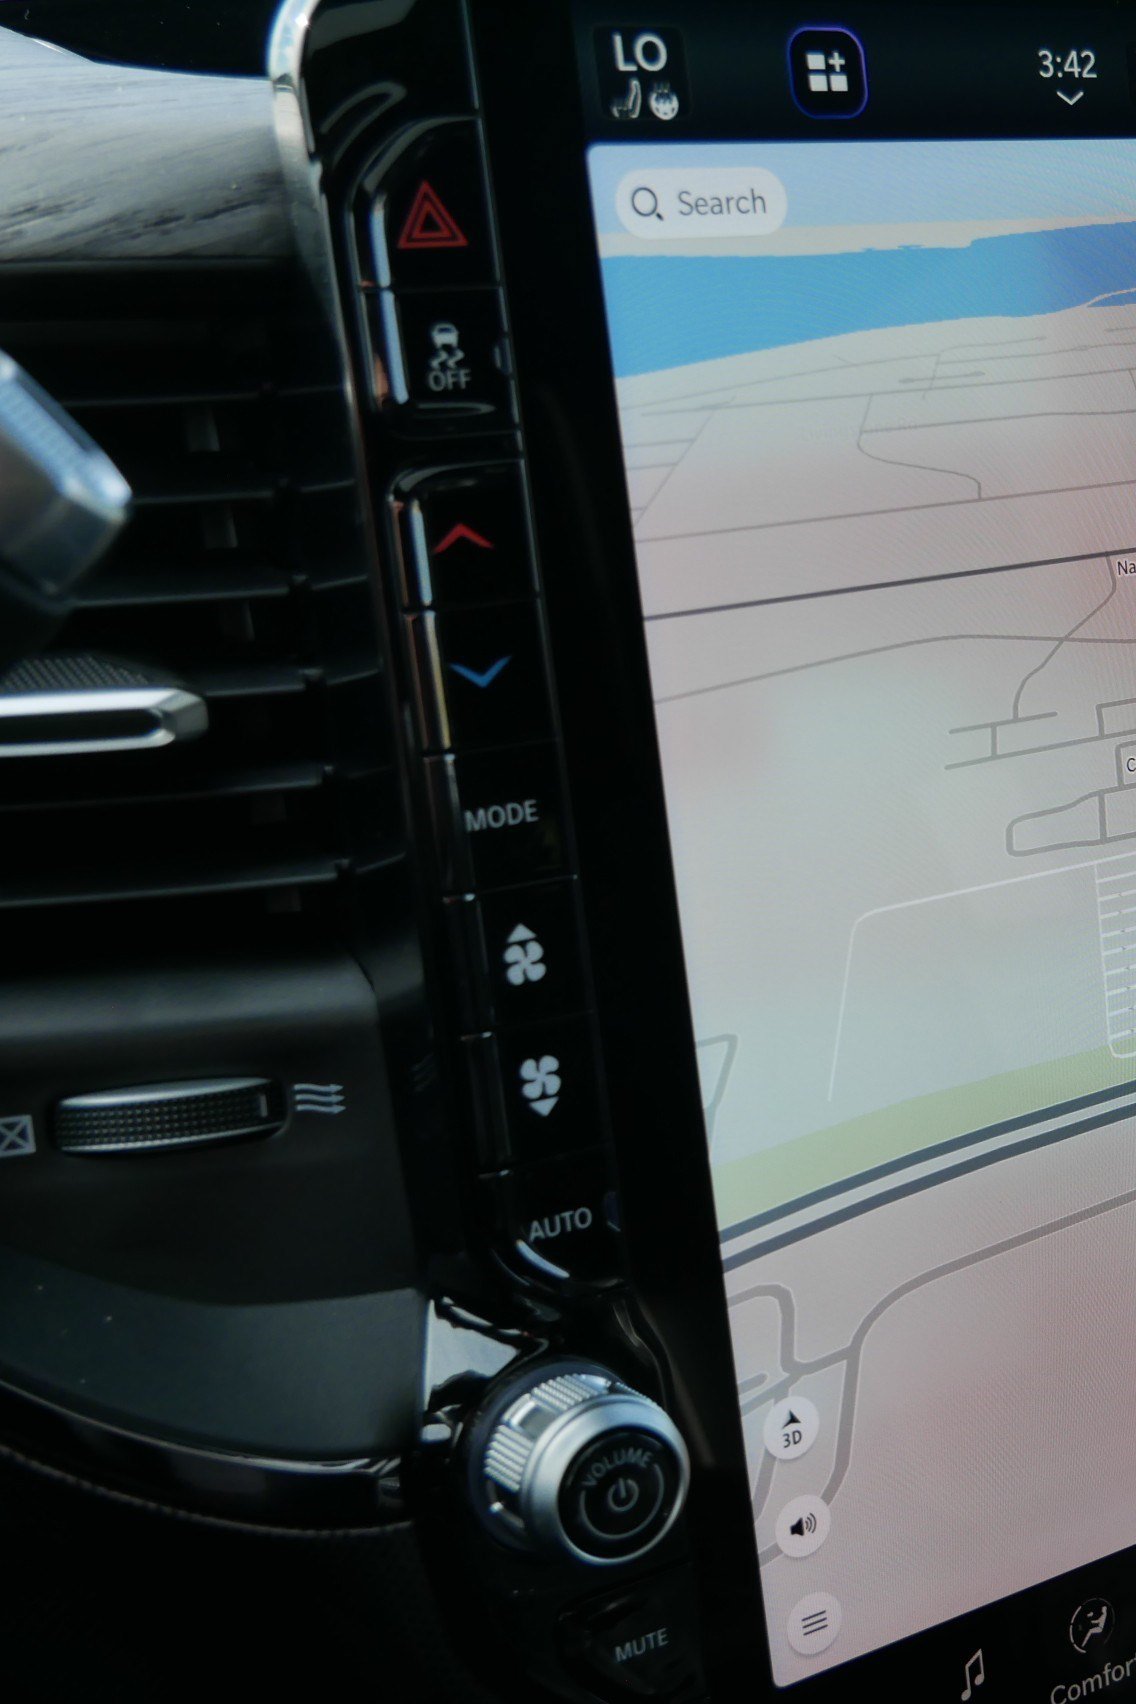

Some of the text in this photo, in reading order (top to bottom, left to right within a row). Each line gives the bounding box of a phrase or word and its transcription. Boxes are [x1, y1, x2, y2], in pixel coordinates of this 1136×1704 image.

[613, 33, 667, 72] LO
[1038, 50, 1097, 79] 3:42
[678, 188, 767, 217] Search
[428, 369, 471, 391] OFF
[464, 799, 539, 832] MODE
[529, 1207, 592, 1242] AUTO
[783, 1430, 802, 1449] 3D
[581, 1447, 653, 1486] VOLUME
[614, 1628, 669, 1664] MUTE
